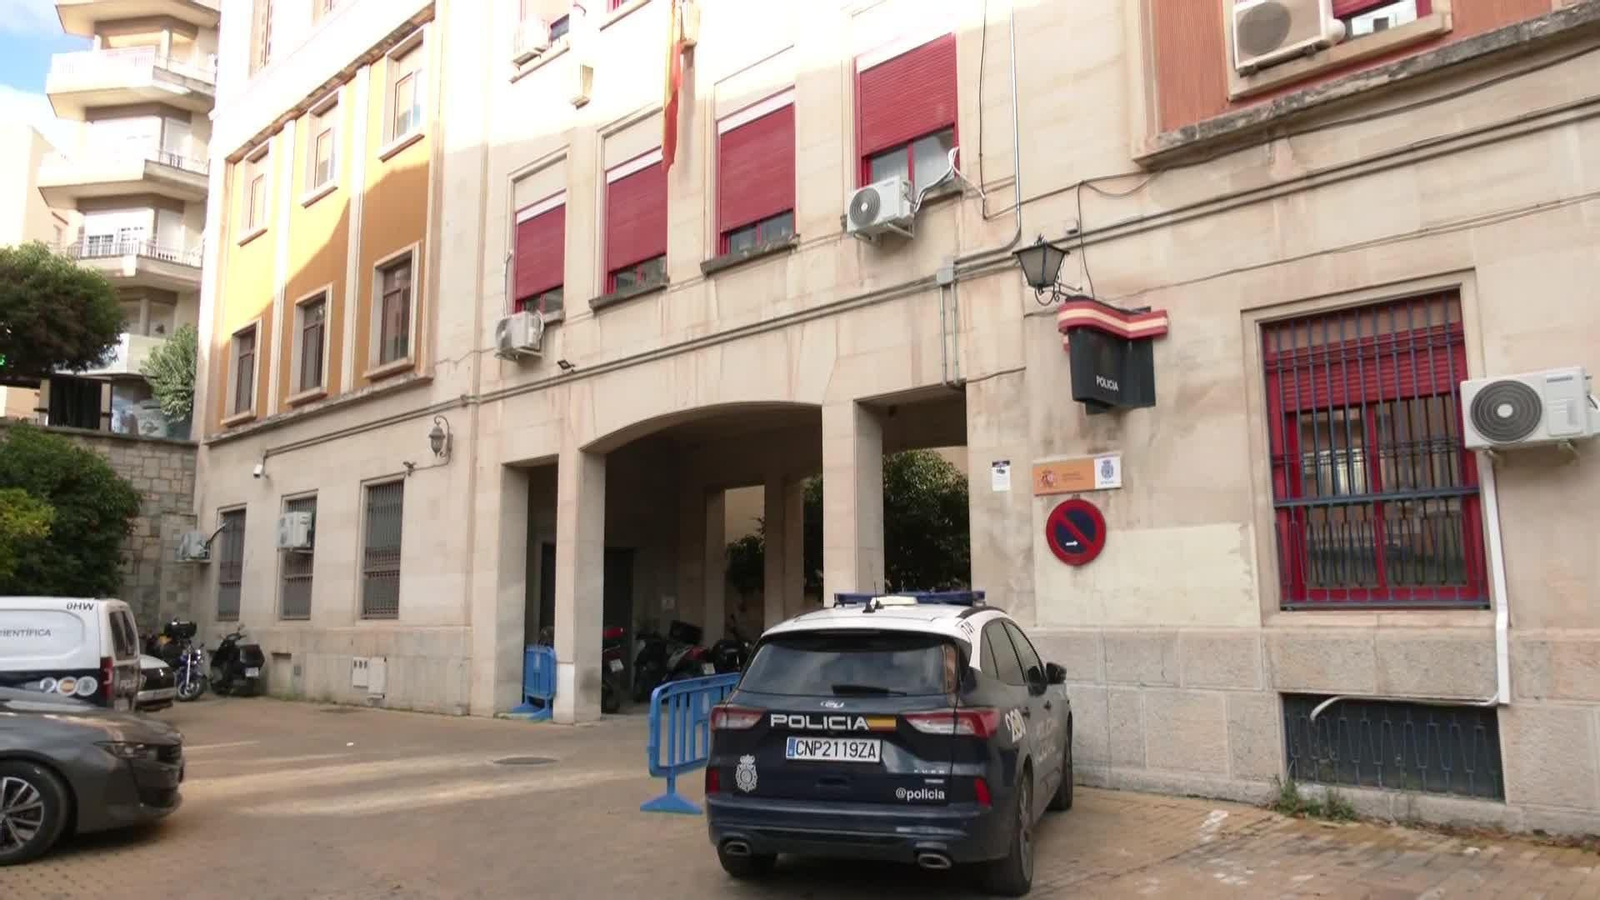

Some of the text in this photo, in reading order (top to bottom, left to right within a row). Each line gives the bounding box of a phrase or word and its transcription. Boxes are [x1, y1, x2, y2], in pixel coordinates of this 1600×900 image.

[770, 713, 869, 731] POLICIA
[795, 740, 876, 759] CNP2119ZA
[895, 787, 946, 802] @policia
